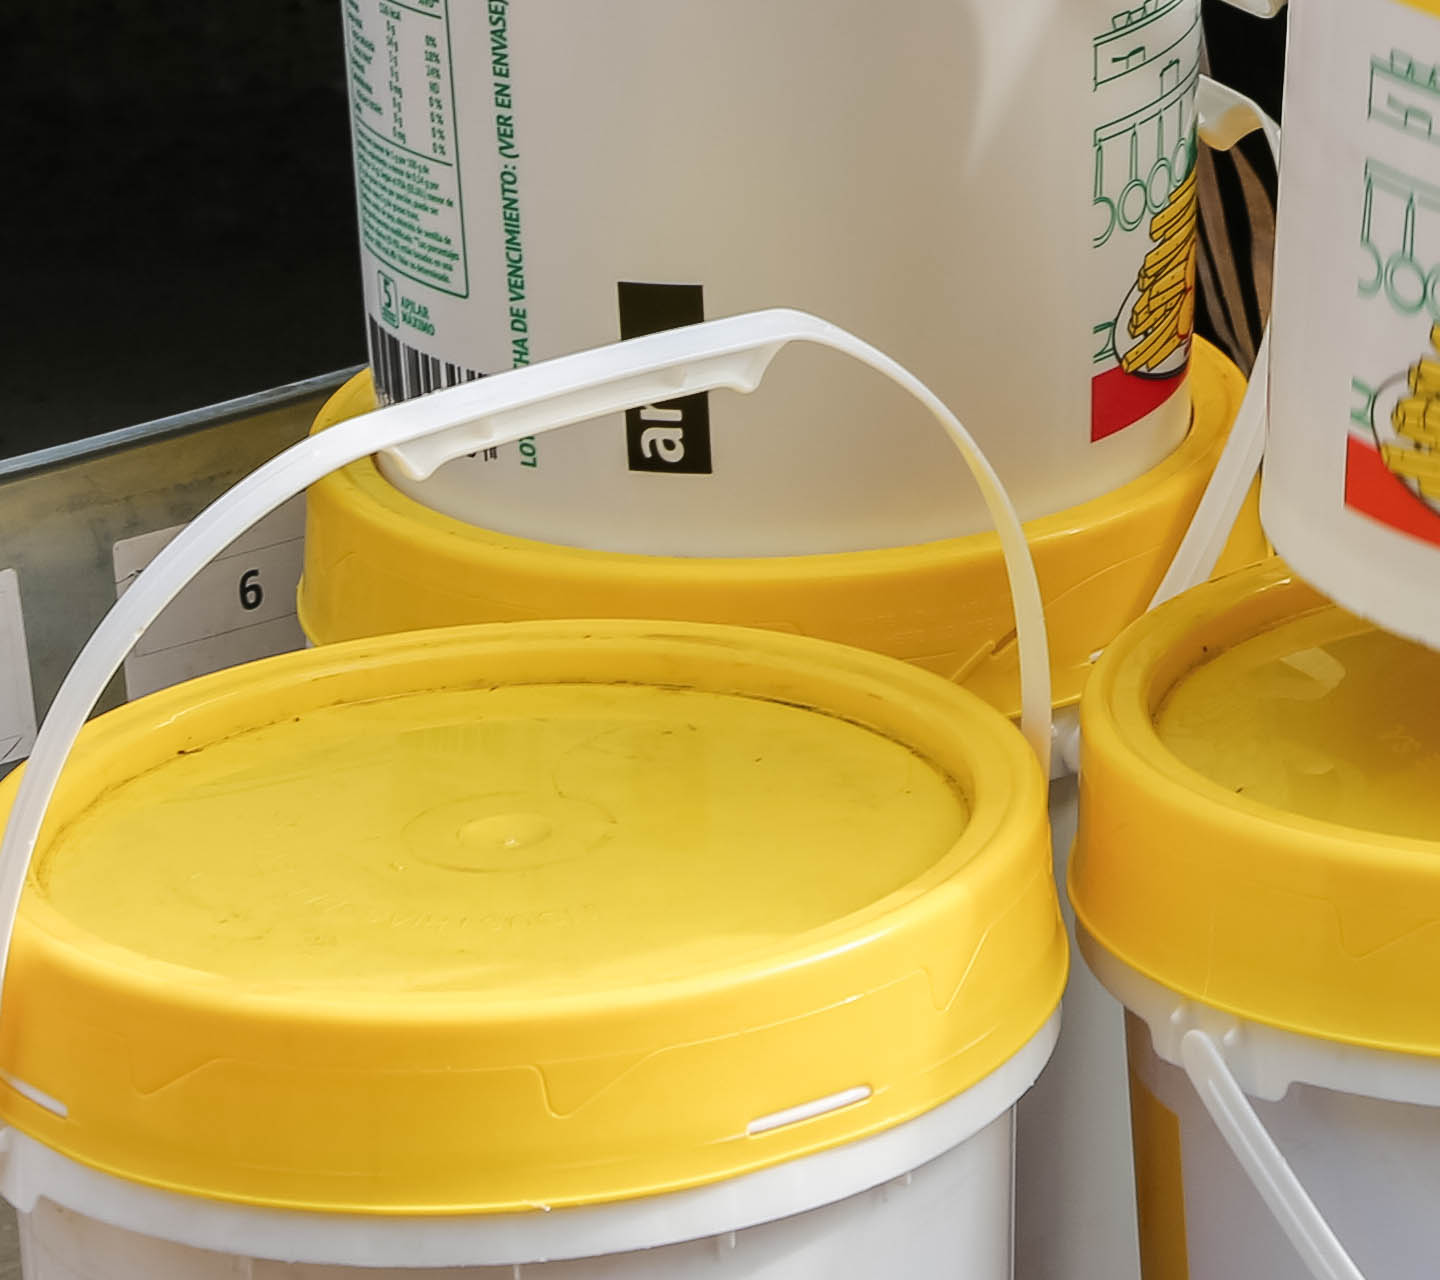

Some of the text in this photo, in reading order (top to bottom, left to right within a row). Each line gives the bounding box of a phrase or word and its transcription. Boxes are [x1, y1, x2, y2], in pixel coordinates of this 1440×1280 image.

[493, 82, 512, 109] EN
[496, 114, 520, 159] (VER
[499, 163, 526, 303] VENCIMIENTO:
[383, 276, 392, 309] 5
[509, 306, 528, 334] DE
[639, 403, 686, 464] ar
[237, 567, 263, 611] 6
